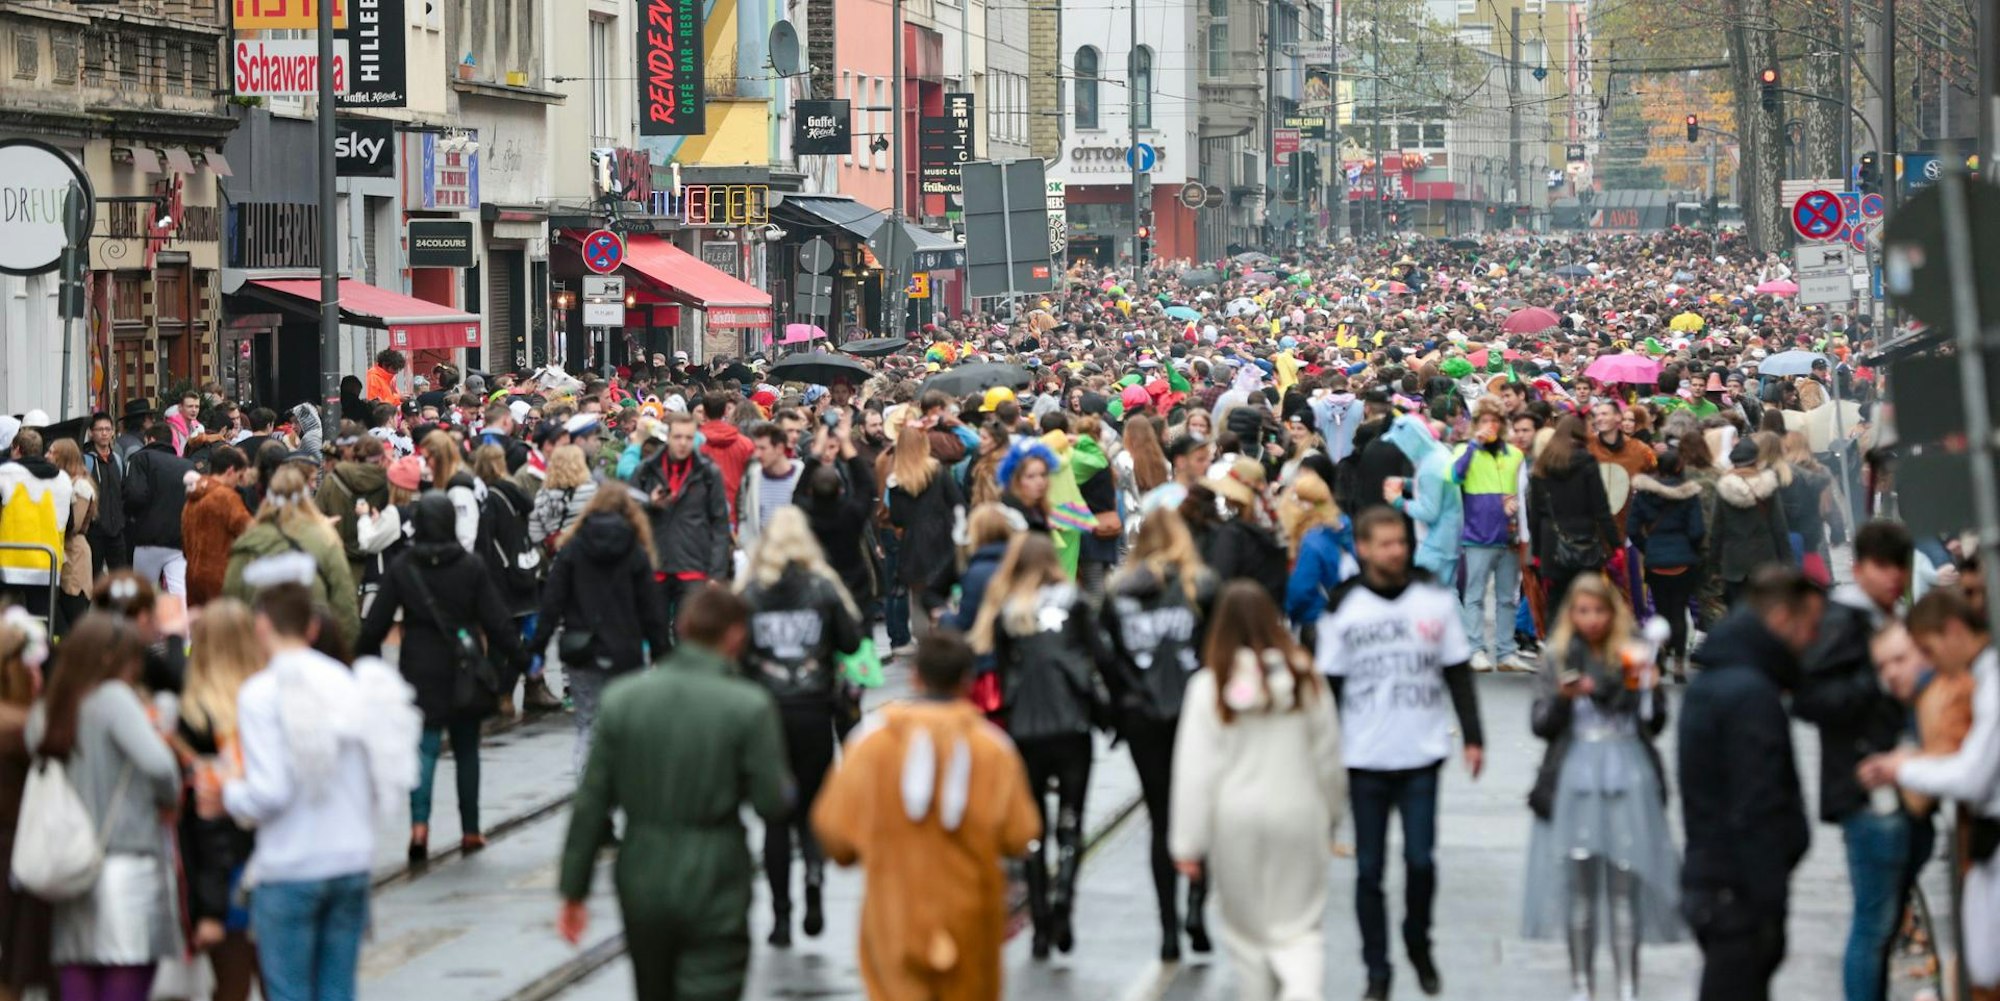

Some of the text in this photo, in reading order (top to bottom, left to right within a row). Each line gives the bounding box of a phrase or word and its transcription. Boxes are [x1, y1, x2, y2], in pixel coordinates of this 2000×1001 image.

[236, 42, 344, 92] Schawara
[680, 48, 694, 72] BAR
[679, 83, 694, 114] CAFÉ
[335, 131, 385, 164] sky
[1071, 147, 1165, 160] OTTOMS
[1045, 182, 1063, 192] SK
[4, 187, 66, 224] DRFUE
[1609, 209, 1638, 227] AWB
[245, 203, 320, 267] HILLEBRAN
[416, 239, 467, 248] 24COLOURS
[714, 264, 734, 274] OXES
